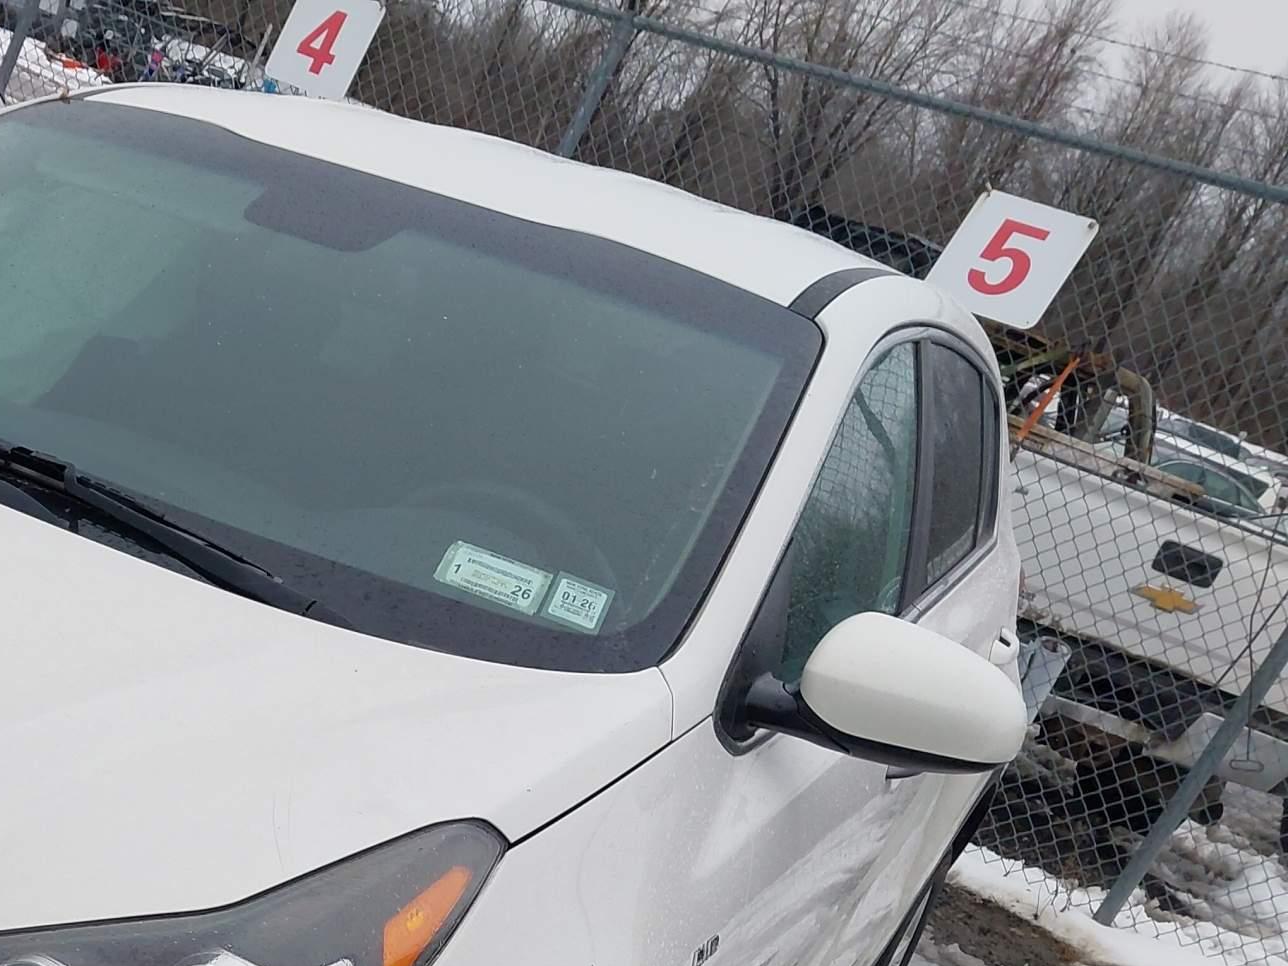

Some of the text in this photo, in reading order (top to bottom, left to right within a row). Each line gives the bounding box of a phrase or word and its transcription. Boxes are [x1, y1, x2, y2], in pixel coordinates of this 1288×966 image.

[296, 10, 348, 76] 4
[967, 218, 1051, 296] 5
[453, 563, 462, 575] 1
[510, 584, 533, 601] 26
[561, 591, 577, 604] 01
